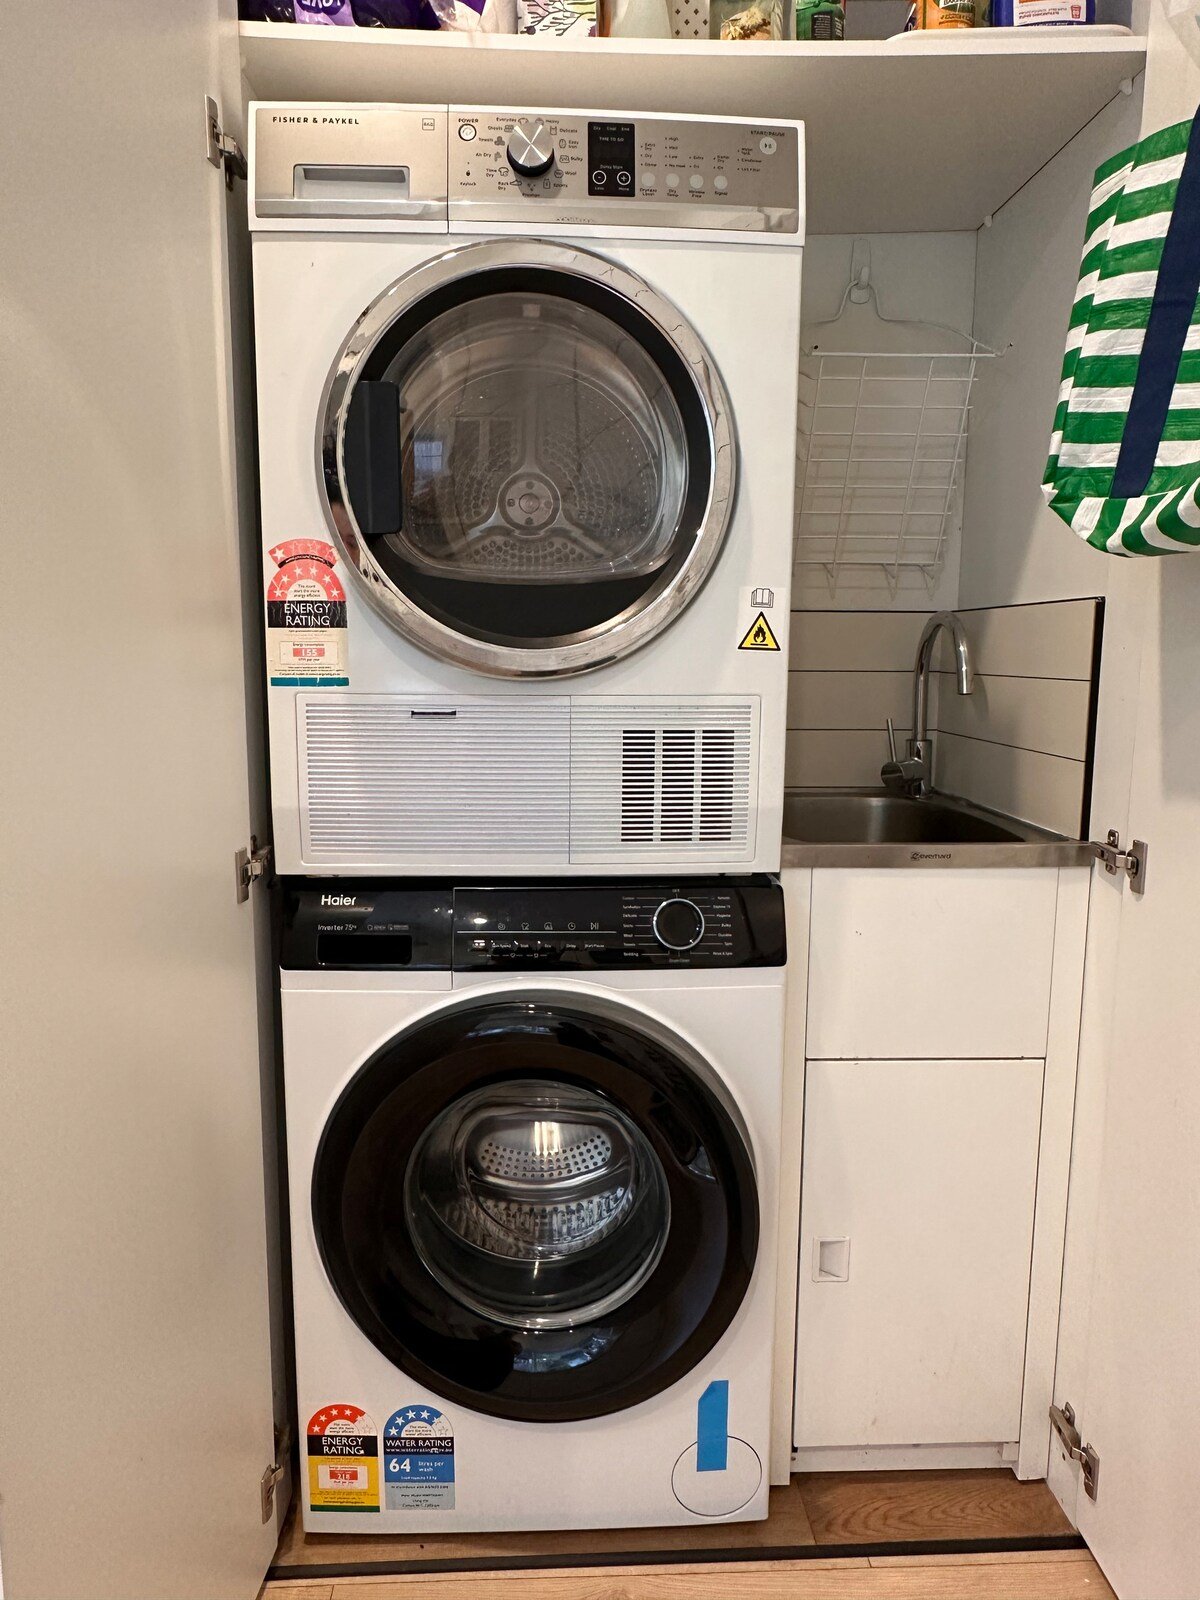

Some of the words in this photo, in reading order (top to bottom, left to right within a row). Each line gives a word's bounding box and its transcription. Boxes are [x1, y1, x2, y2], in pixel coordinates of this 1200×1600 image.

[272, 116, 309, 124] FISHER
[322, 117, 360, 125] PAYKEL
[284, 603, 331, 614] ENERGY
[285, 615, 331, 626] RATING
[301, 648, 318, 657] 155
[320, 894, 357, 906] Haier
[321, 1436, 363, 1446] ENERGY
[385, 1439, 417, 1447] WATER
[418, 1439, 452, 1447] RATING
[323, 1446, 364, 1455] RATING
[389, 1458, 411, 1473] 64
